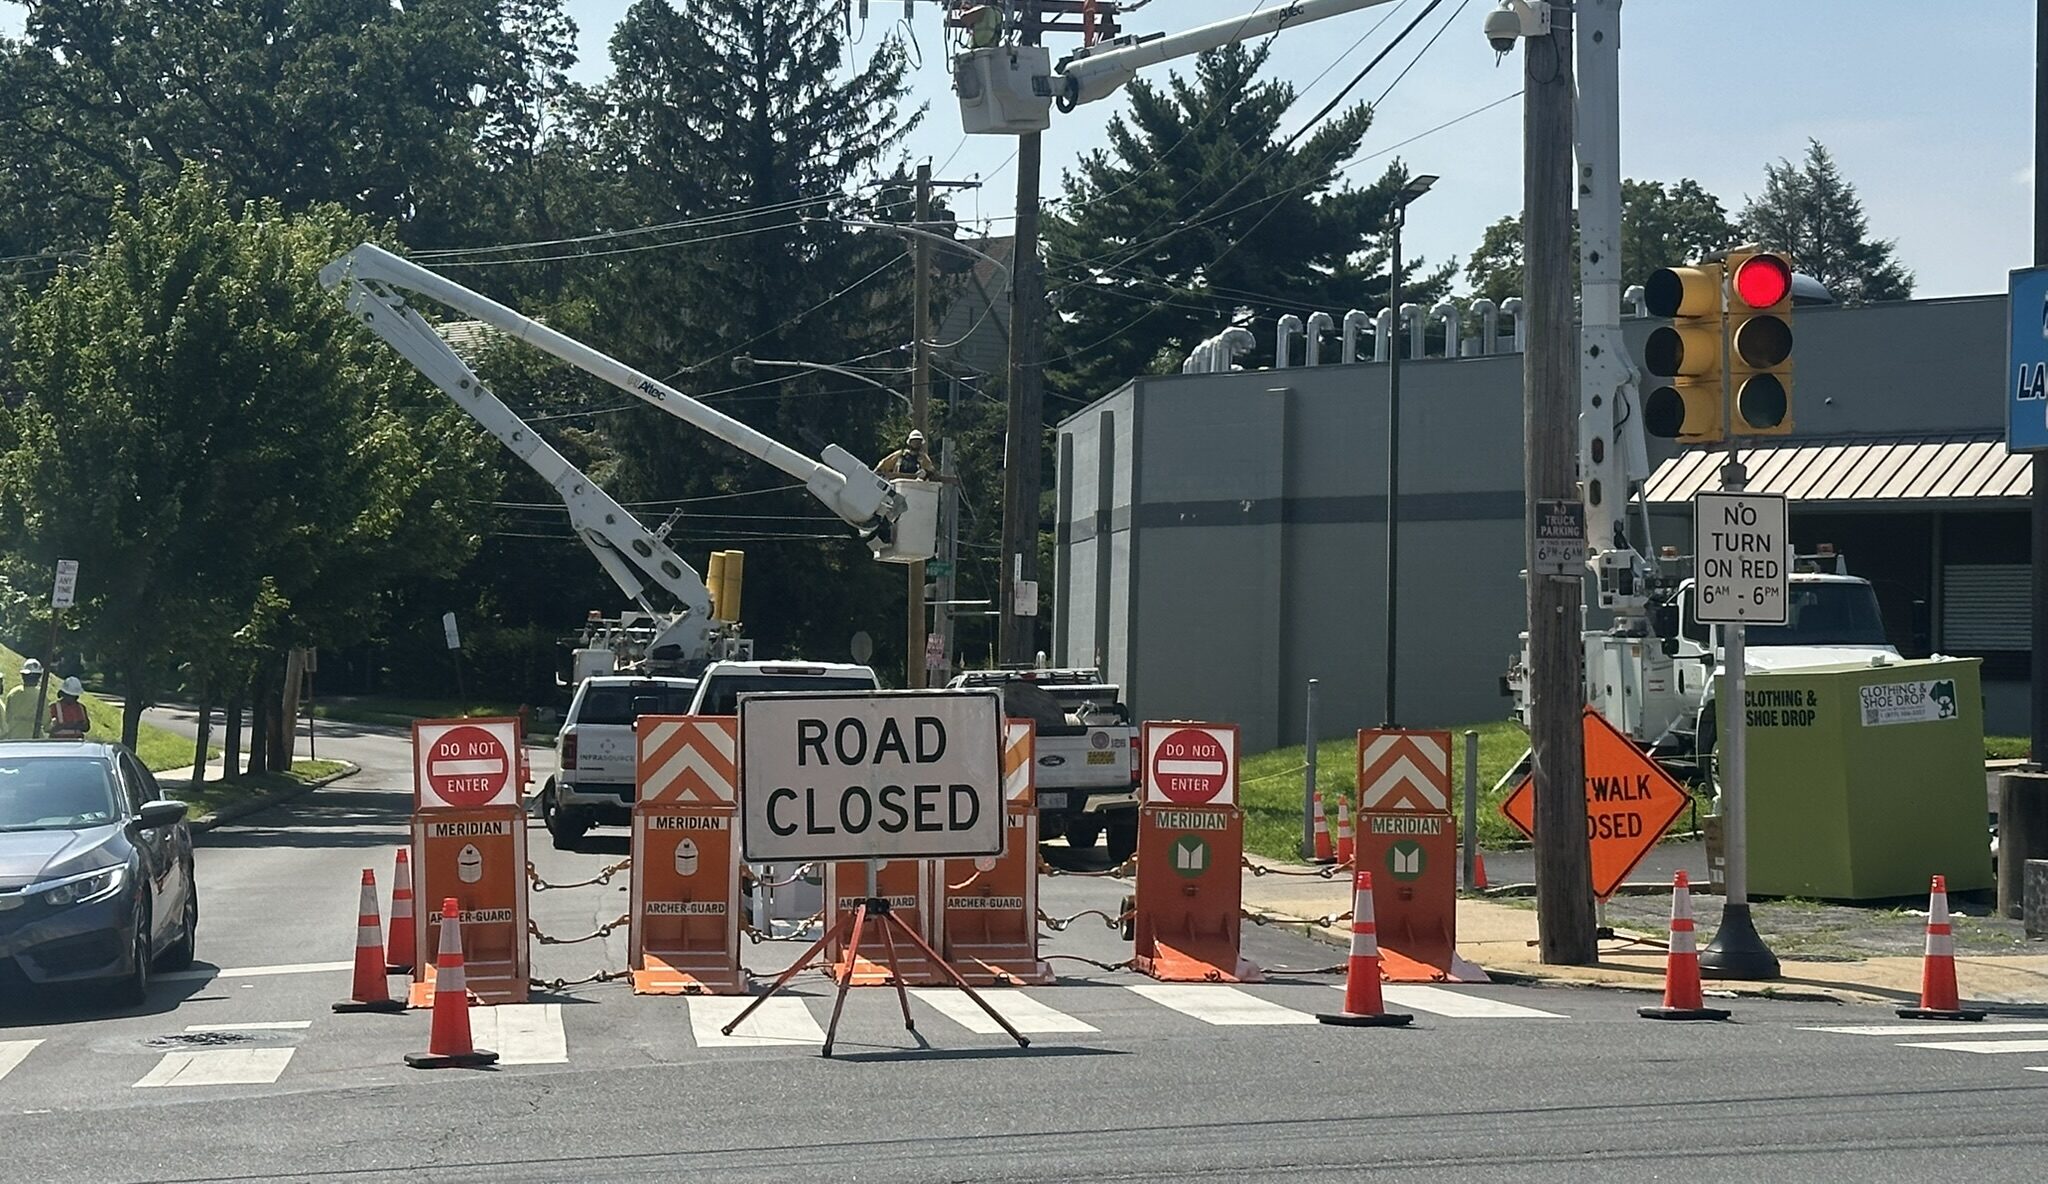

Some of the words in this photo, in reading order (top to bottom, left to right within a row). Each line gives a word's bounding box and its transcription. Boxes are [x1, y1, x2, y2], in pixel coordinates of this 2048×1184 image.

[2017, 361, 2048, 401] LA
[638, 380, 666, 401] Altec
[1553, 505, 1567, 515] NO
[1724, 506, 1757, 526] NO
[1545, 515, 1575, 526] TRUCK
[1540, 526, 1580, 536] PARKING
[1711, 532, 1771, 553] TURN
[1704, 558, 1732, 578] ON
[1741, 560, 1778, 579] RED
[1703, 585, 1730, 604] 6AM
[1753, 586, 1779, 606] 6PM
[1860, 684, 1916, 698] CLOTHING
[1919, 683, 1927, 693] &
[1744, 690, 1802, 707] CLOTHING
[1806, 690, 1817, 706] &
[1864, 696, 1893, 709] SHOE
[1896, 694, 1926, 706] DROP
[1746, 710, 1778, 727] SHOE
[1781, 709, 1815, 726] DROP
[798, 717, 947, 766] ROAD
[440, 744, 460, 757] DO
[469, 742, 495, 755] NOT
[1166, 744, 1184, 756] DO
[1192, 745, 1217, 757] NOT
[447, 778, 489, 793] ENTER
[1171, 778, 1210, 791] ENTER
[766, 785, 980, 836] CLOSED
[656, 816, 720, 830] MERIDIAN
[1157, 813, 1226, 829] MERIDIAN
[1372, 818, 1440, 834] MERIDIAN
[436, 822, 502, 837] MERIDIAN
[647, 903, 725, 914] ARCHER-GUARD
[948, 898, 1022, 908] ARCHER-GUARD
[430, 910, 512, 924] ARER-GUARD
